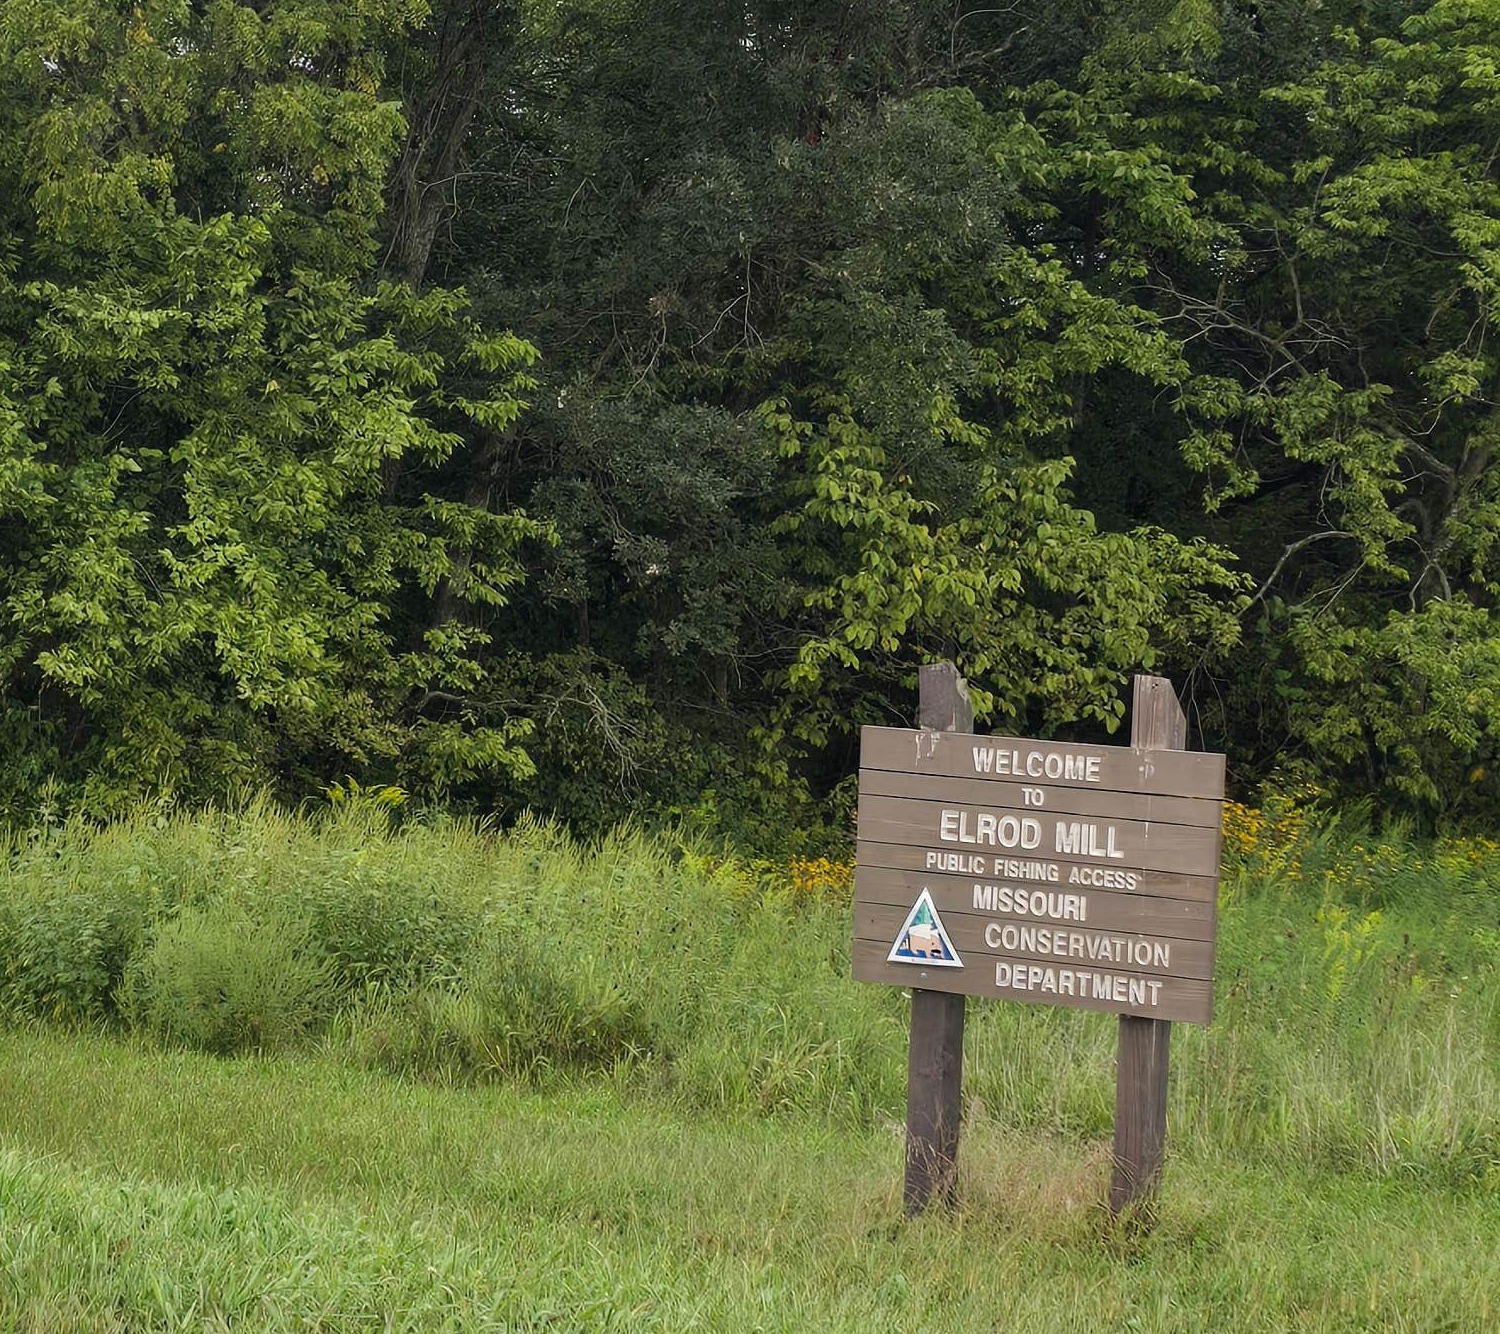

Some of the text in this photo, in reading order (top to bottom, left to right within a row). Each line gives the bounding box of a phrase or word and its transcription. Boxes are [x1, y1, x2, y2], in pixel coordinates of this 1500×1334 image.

[972, 747, 1101, 782] WELCOME
[1021, 787, 1044, 806] TO
[940, 809, 1125, 859] ELROD MILL
[926, 851, 1138, 890] PUBLIC FISHING ACCESS
[972, 885, 1088, 922] MISSOURI
[984, 922, 1170, 968] CONSERVATION
[995, 962, 1163, 1006] DEPARTMENT
